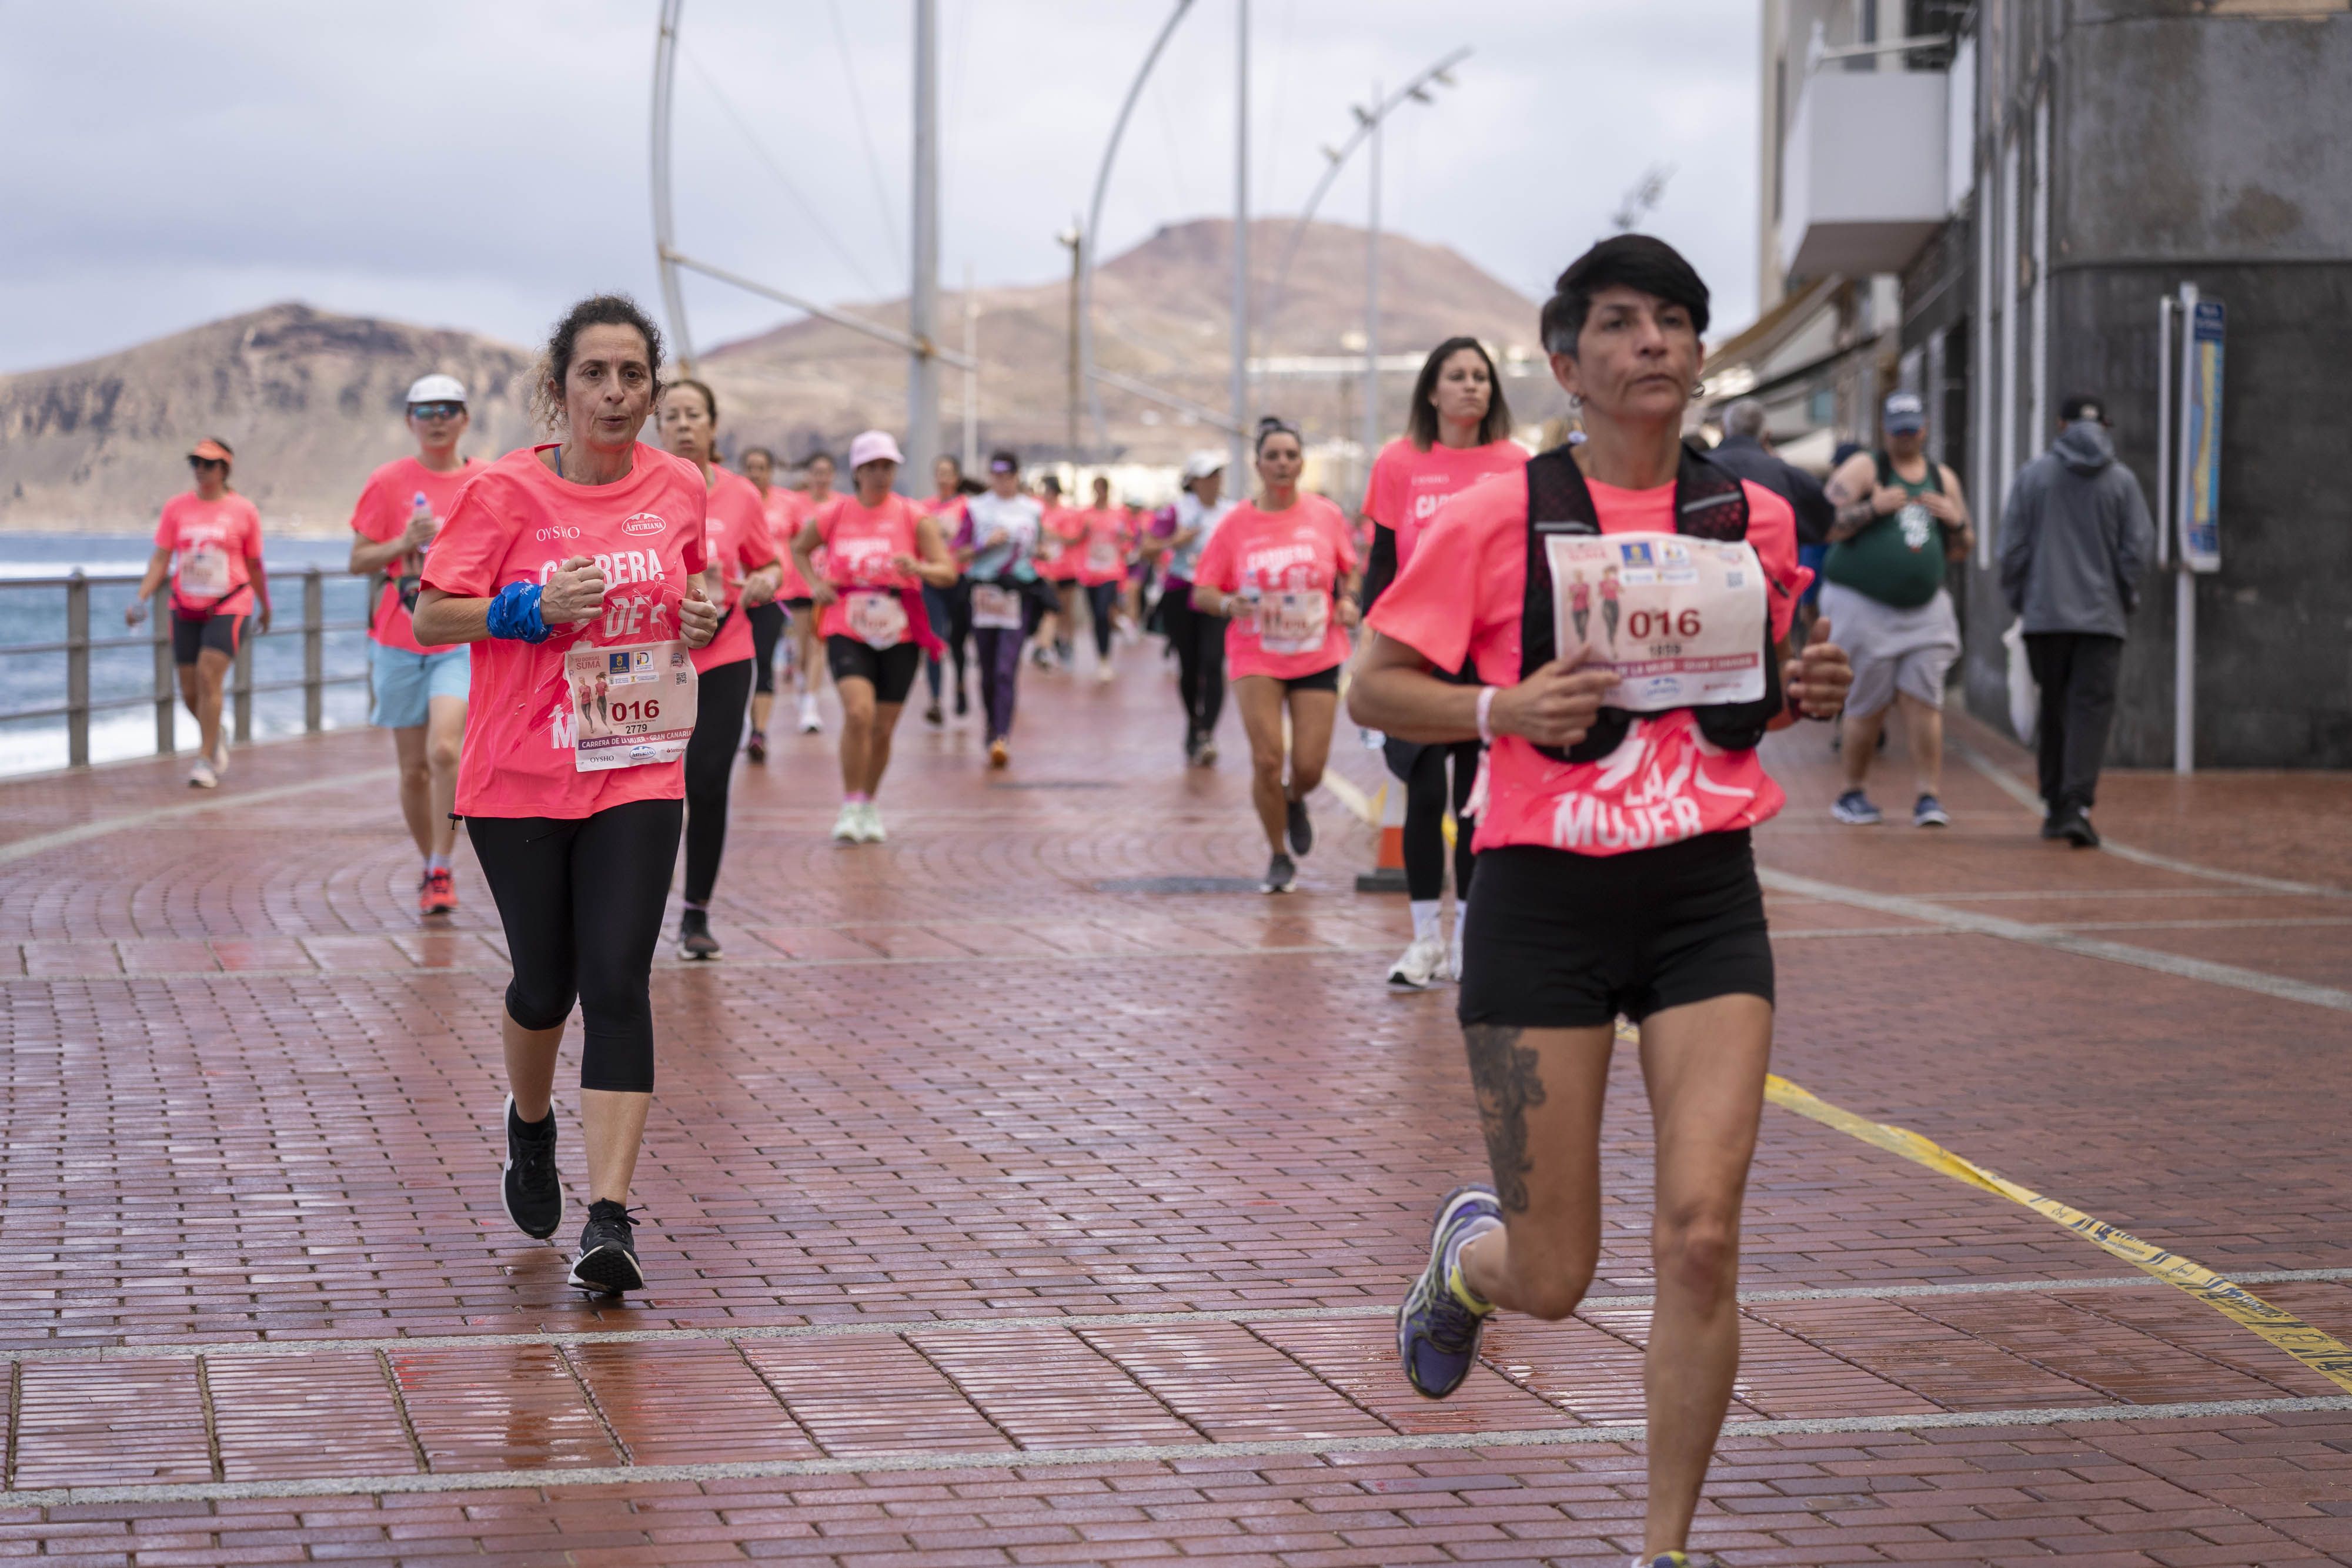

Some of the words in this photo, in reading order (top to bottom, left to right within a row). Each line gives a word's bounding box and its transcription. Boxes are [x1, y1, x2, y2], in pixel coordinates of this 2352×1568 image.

[536, 526, 580, 541] OYSHO
[626, 521, 663, 531] ASTURIANA
[540, 548, 665, 587] CRERA
[603, 594, 650, 638] DE
[1628, 609, 1701, 639] 016
[576, 661, 601, 670] SUMA
[612, 699, 660, 722] 016
[582, 739, 610, 748] CARRERA
[666, 730, 692, 739] CANARIA
[626, 724, 647, 734] 2779
[1624, 761, 1663, 806] LA
[1553, 791, 1703, 848] MUJER
